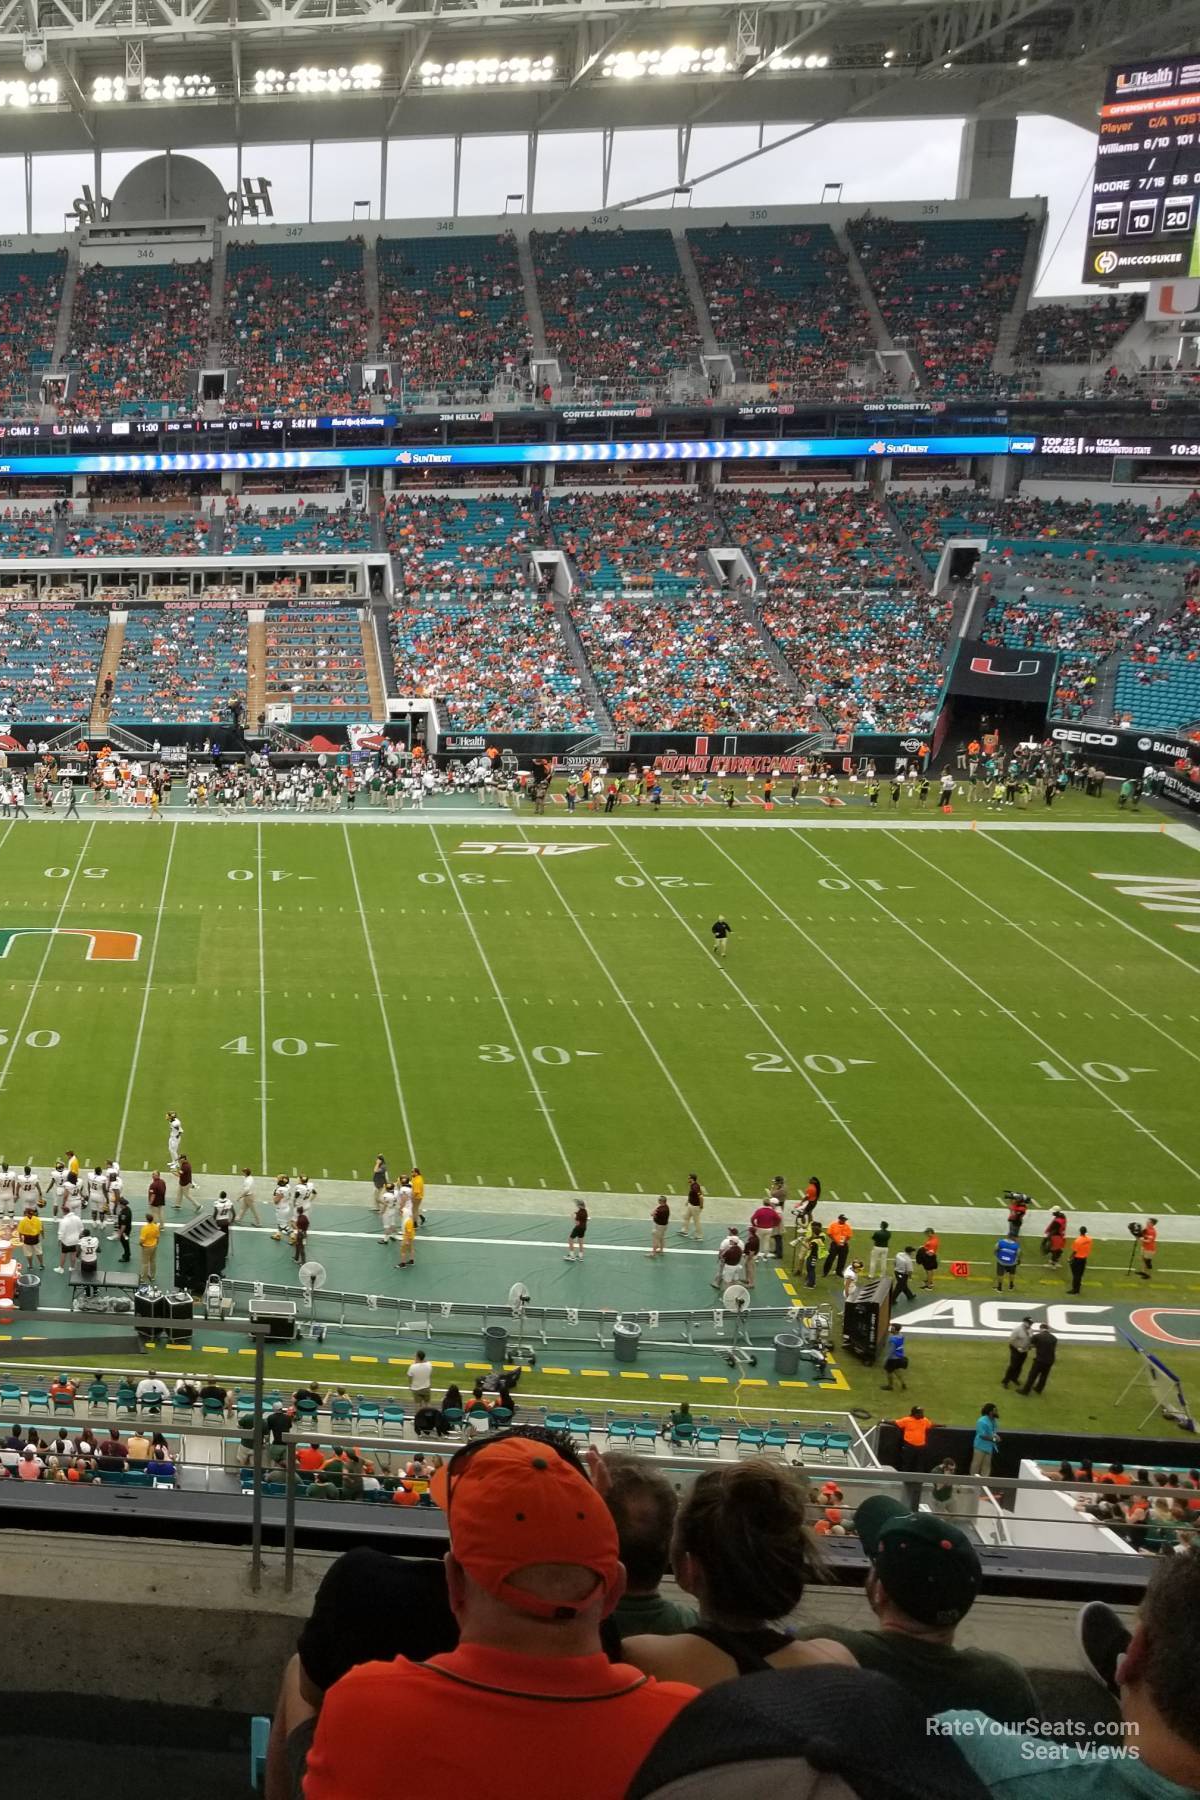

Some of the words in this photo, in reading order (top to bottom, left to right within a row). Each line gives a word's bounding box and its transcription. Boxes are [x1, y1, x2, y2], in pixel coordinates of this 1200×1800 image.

[1101, 122, 1133, 134] Player
[1148, 116, 1168, 128] C/A
[1098, 143, 1139, 155] Williams
[1176, 135, 1194, 146] 101
[1094, 180, 1131, 193] MOORE
[749, 210, 767, 219] 350
[921, 206, 939, 215] 351
[592, 216, 609, 225] 349
[1097, 218, 1118, 230] 1ST
[1133, 215, 1150, 229] 10
[1166, 211, 1187, 226] 20
[286, 228, 303, 237] 347
[437, 222, 454, 231] 348
[137, 250, 154, 258] 346
[1118, 253, 1182, 266] MICCOSUKEE
[563, 410, 594, 418] CORTEZ
[597, 409, 635, 417] KENNEDY
[11, 427, 30, 435] CMU
[73, 426, 89, 434] MIA
[228, 422, 237, 430] 10
[273, 421, 282, 429] 20
[1043, 438, 1061, 446] TOP
[1042, 446, 1076, 454] SCORES
[1052, 729, 1118, 746] GEICO
[654, 757, 710, 772] MIAMI
[219, 1035, 308, 1056] 40
[477, 1044, 572, 1066] 30
[744, 1053, 849, 1075] 20
[1031, 1061, 1131, 1084] 10
[955, 1262, 968, 1275] 20
[890, 1299, 1115, 1341] ACC
